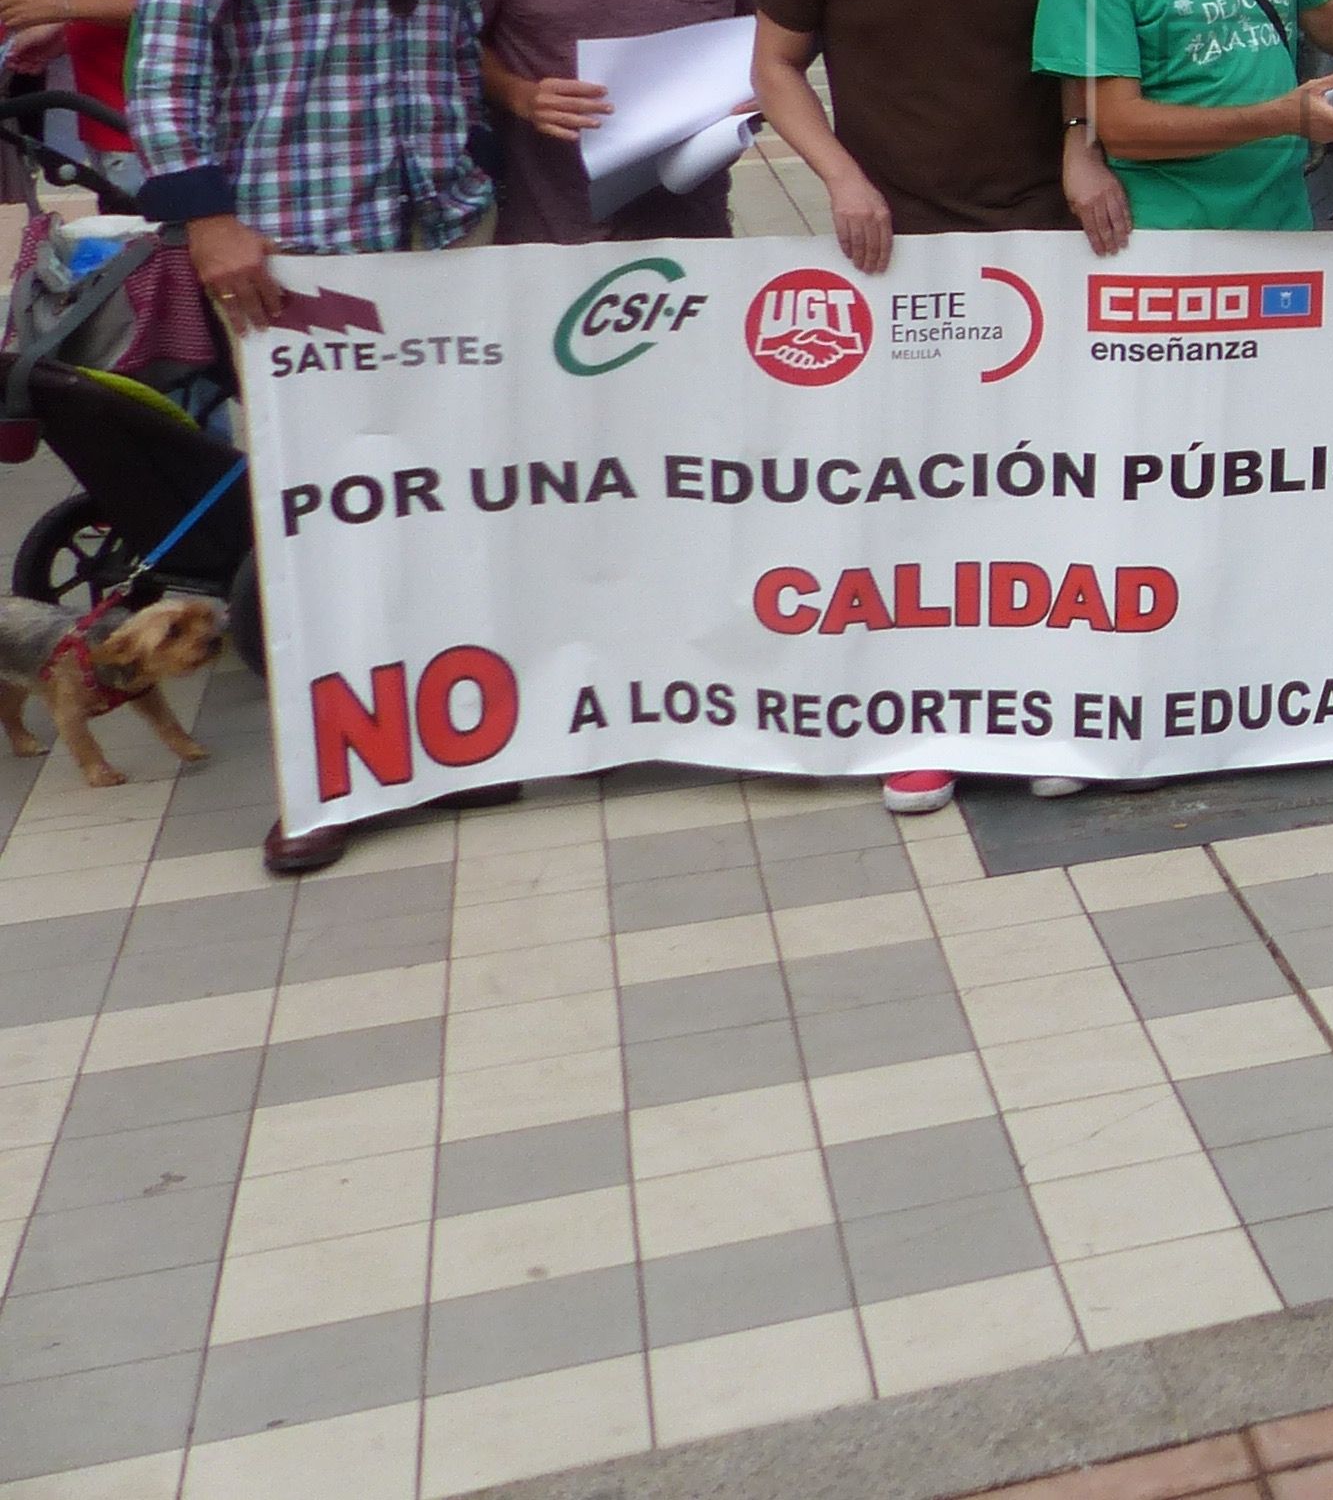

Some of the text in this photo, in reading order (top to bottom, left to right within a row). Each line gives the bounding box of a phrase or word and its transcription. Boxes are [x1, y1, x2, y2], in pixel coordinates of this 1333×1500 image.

[759, 288, 858, 338] UGT
[892, 292, 966, 321] FETE
[1099, 285, 1249, 322] CCOO
[892, 322, 1003, 344] Enseñanza
[1090, 336, 1259, 363] enseñanza
[271, 336, 503, 378] SATE-STEs
[891, 348, 942, 361] MELILLA
[281, 467, 443, 537] POR
[470, 457, 637, 513] UNA
[664, 439, 1097, 503] EDUCACIÓN
[752, 561, 1179, 636] CALIDAD
[309, 644, 519, 803] NO
[568, 685, 608, 734] A
[630, 680, 736, 727] LOS
[756, 687, 1053, 740] RECORTES
[1074, 692, 1142, 741] EN
